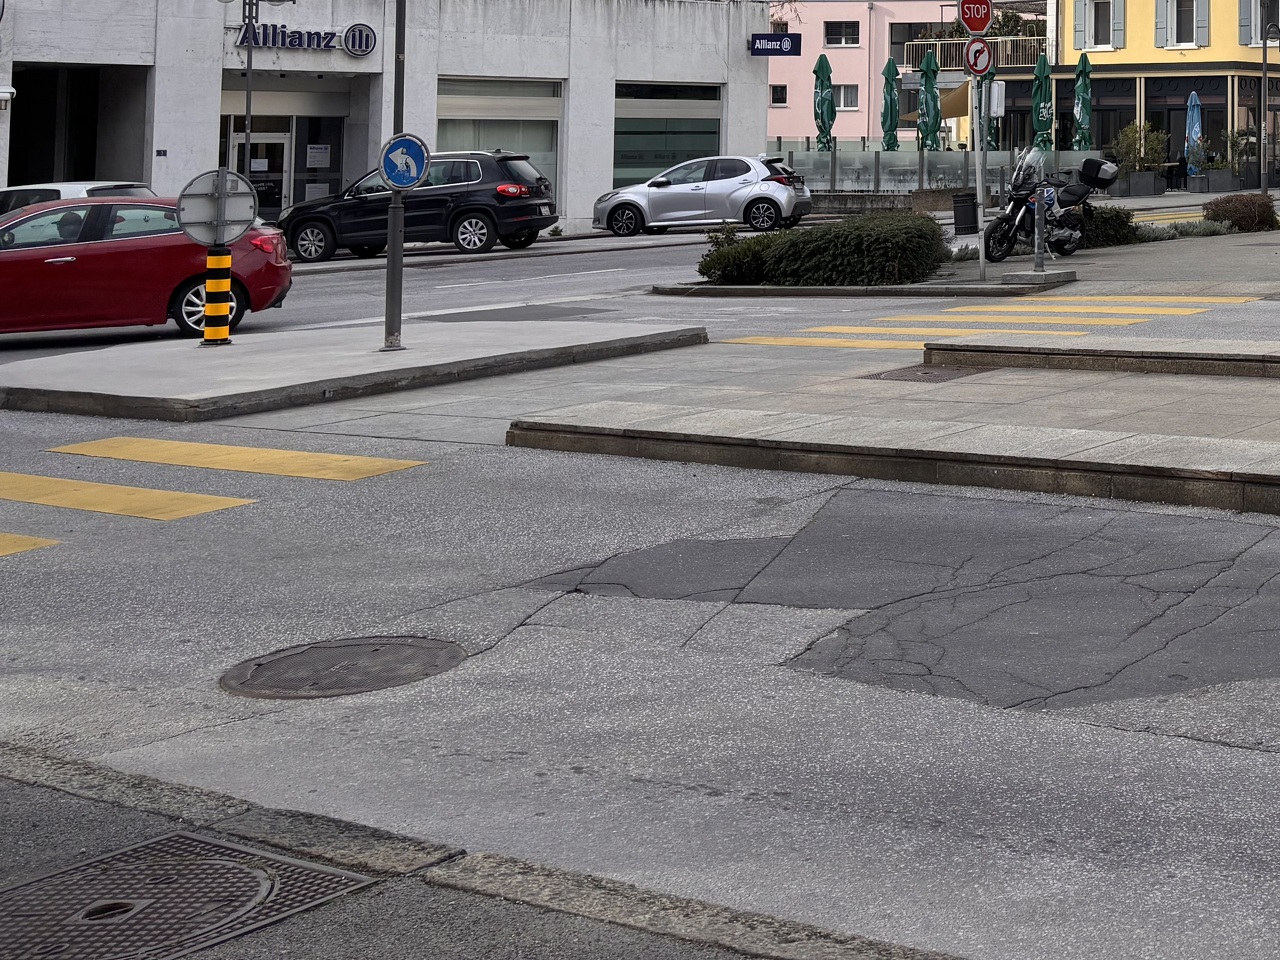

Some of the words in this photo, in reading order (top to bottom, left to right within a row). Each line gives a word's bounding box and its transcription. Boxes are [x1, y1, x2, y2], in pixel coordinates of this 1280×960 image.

[964, 4, 988, 18] STOP
[236, 23, 337, 49] Allianz
[754, 39, 781, 49] Allianz
